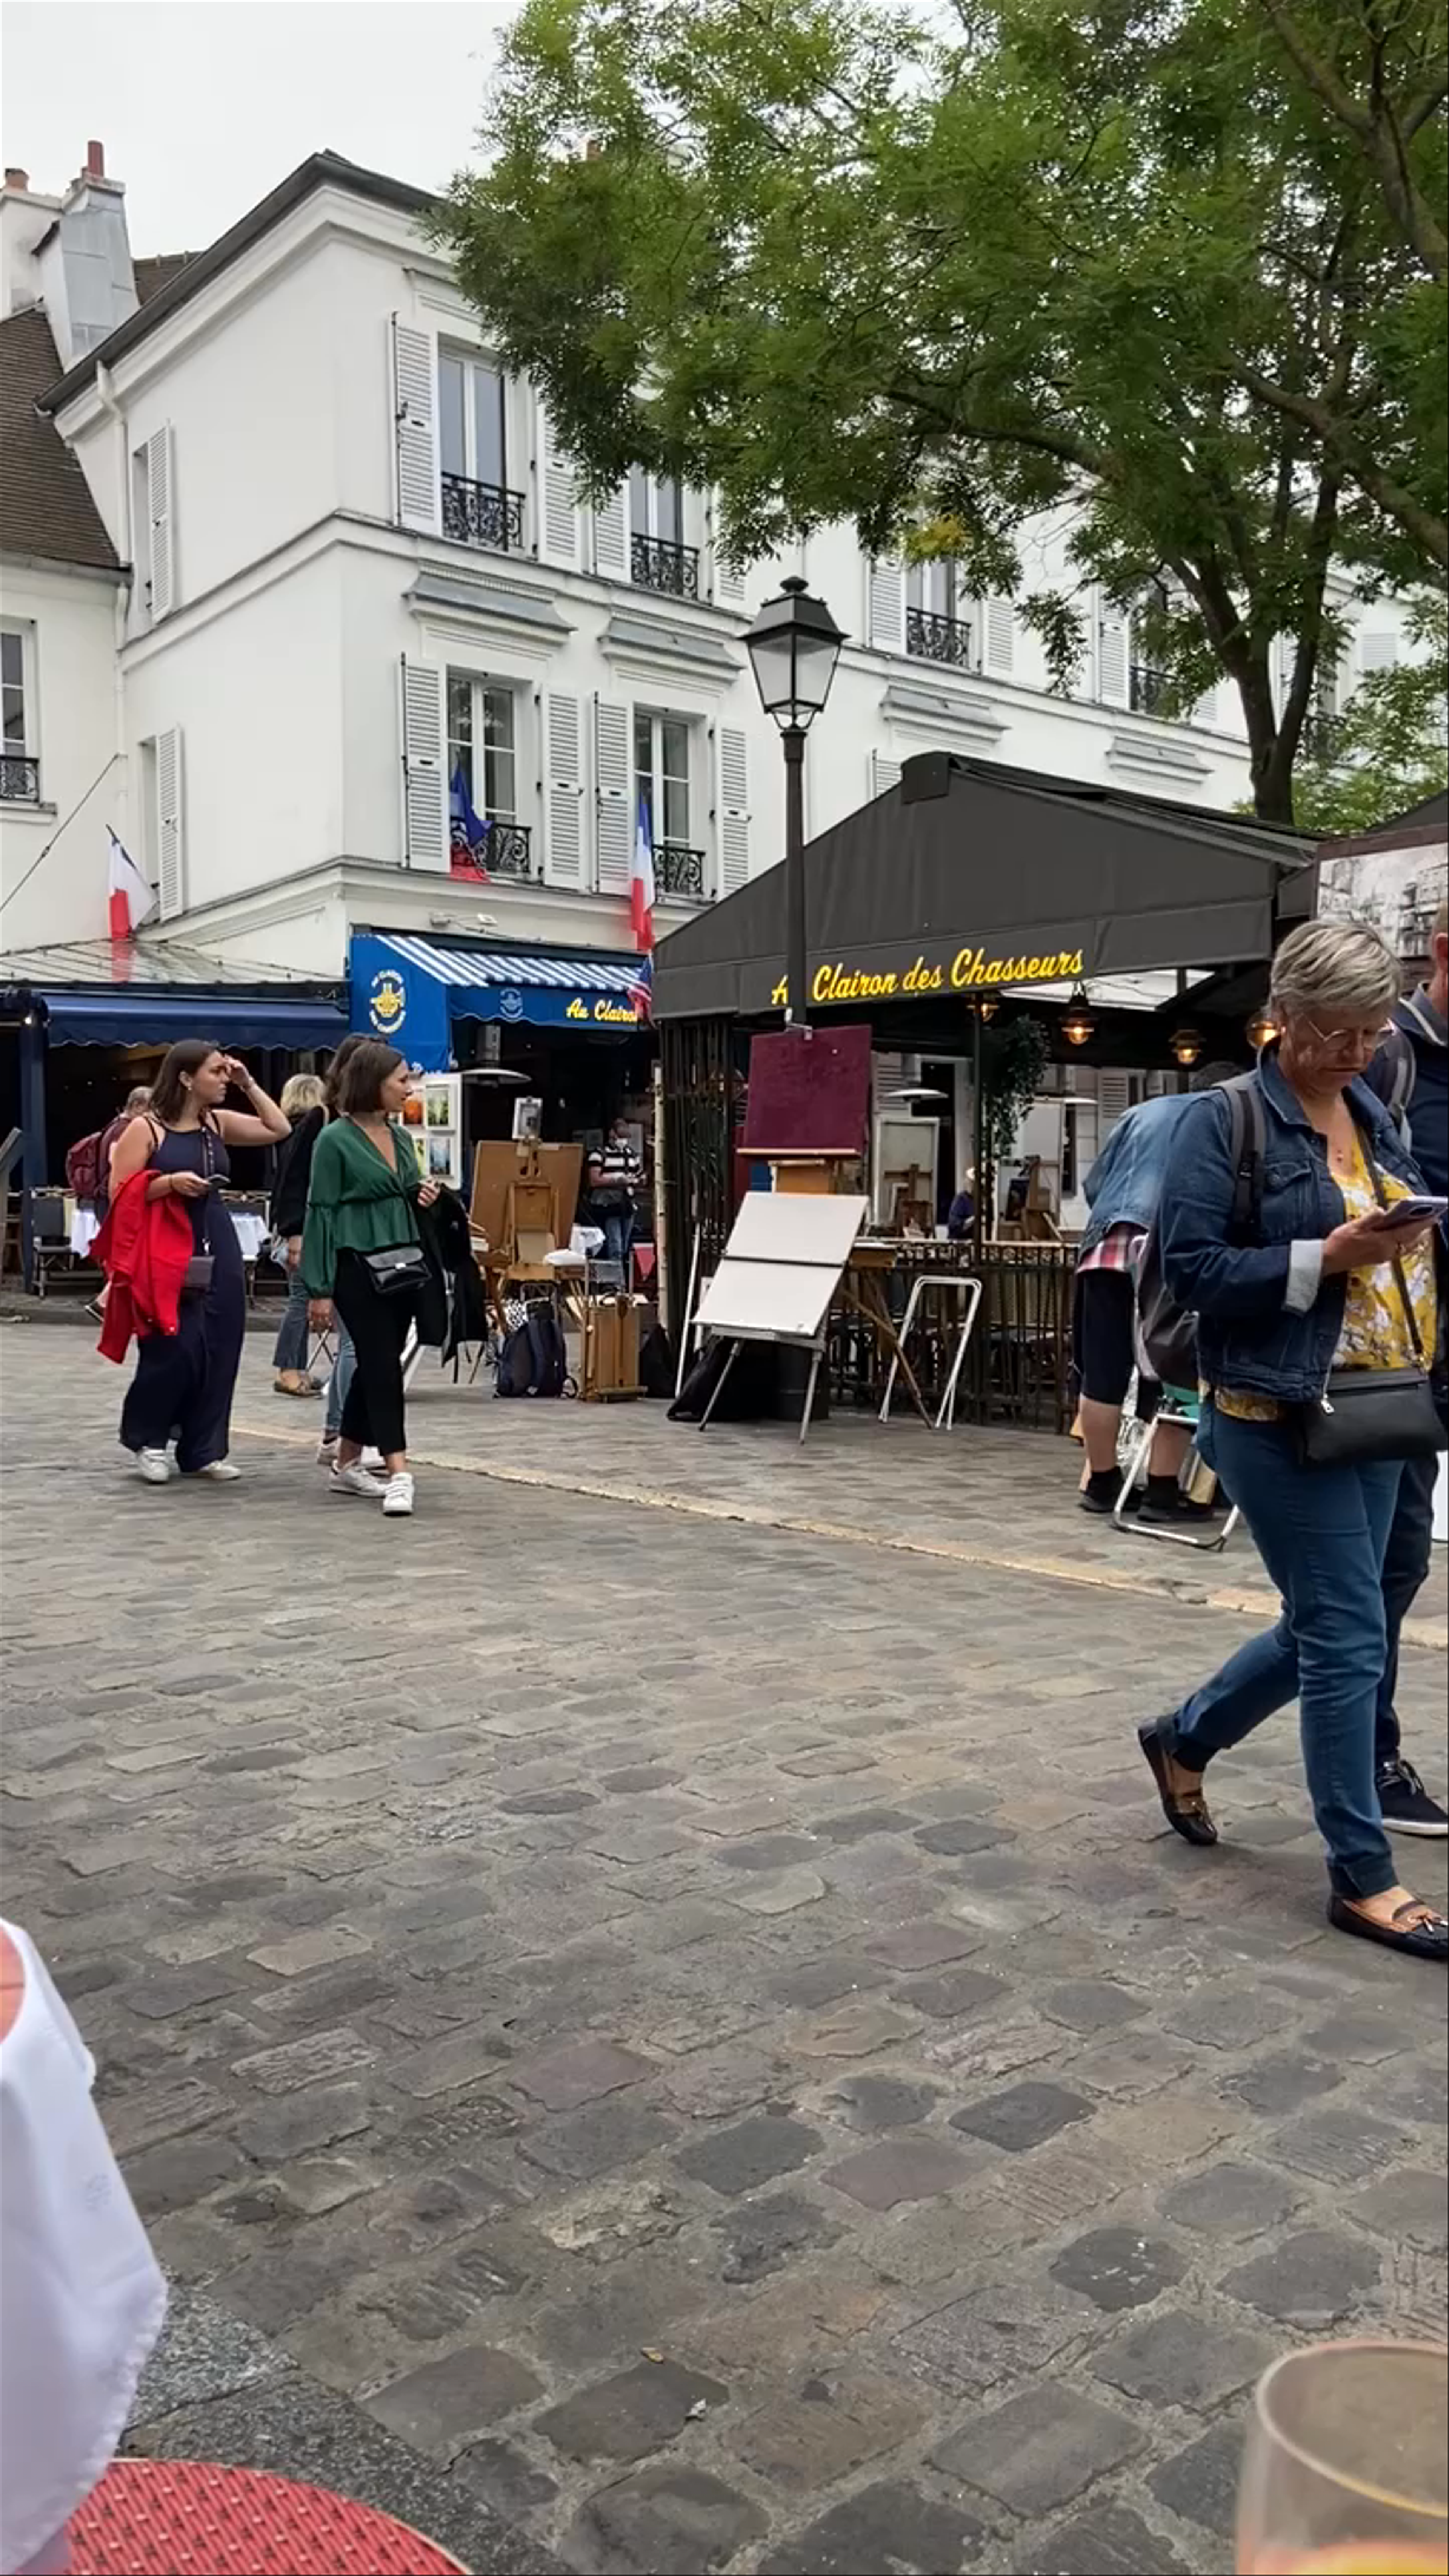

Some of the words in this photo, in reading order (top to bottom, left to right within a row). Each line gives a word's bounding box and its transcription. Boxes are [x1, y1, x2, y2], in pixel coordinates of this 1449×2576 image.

[772, 974, 788, 1005] A
[813, 963, 898, 1001] Clairon
[903, 956, 943, 991] des
[951, 947, 1083, 987] Chasseurs
[566, 997, 589, 1018] Au
